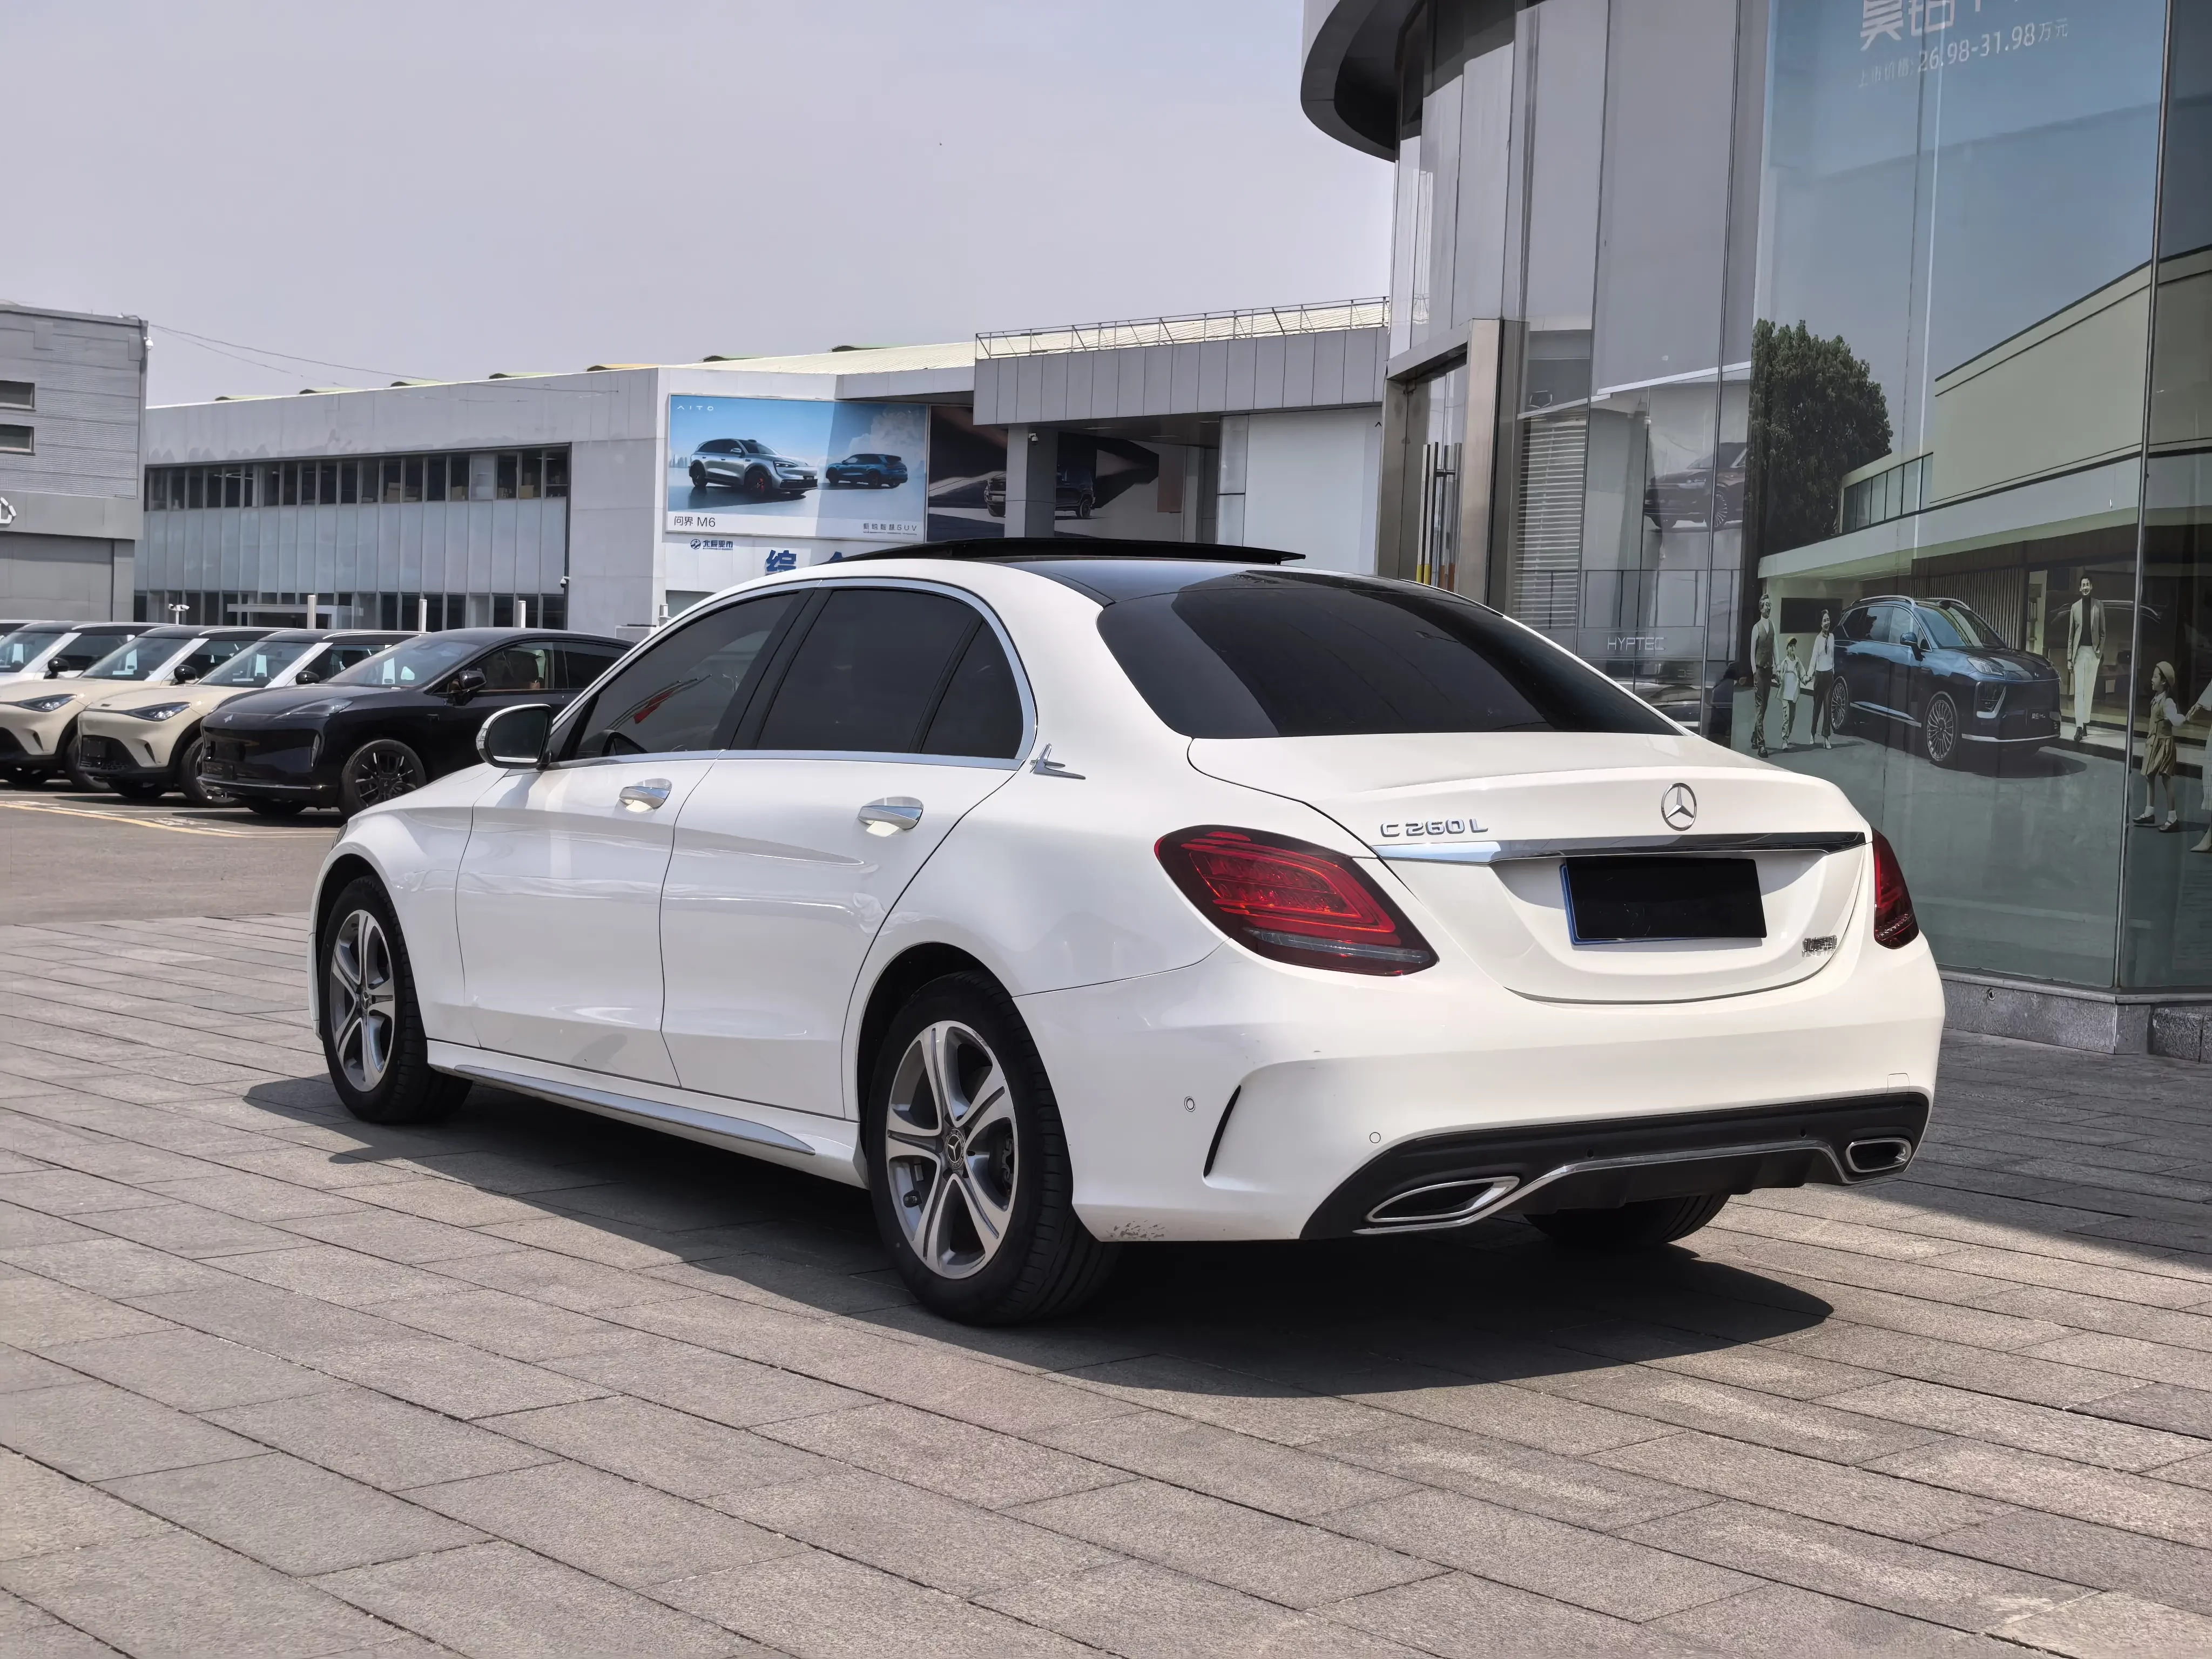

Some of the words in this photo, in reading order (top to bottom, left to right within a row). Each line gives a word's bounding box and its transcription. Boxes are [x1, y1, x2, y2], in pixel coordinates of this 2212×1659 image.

[674, 516, 693, 527] 问界
[697, 517, 716, 527] M6
[1607, 637, 1665, 651] HYPTEC
[1380, 822, 1400, 837] C
[1405, 818, 1465, 837] 260
[1469, 818, 1488, 833] L
